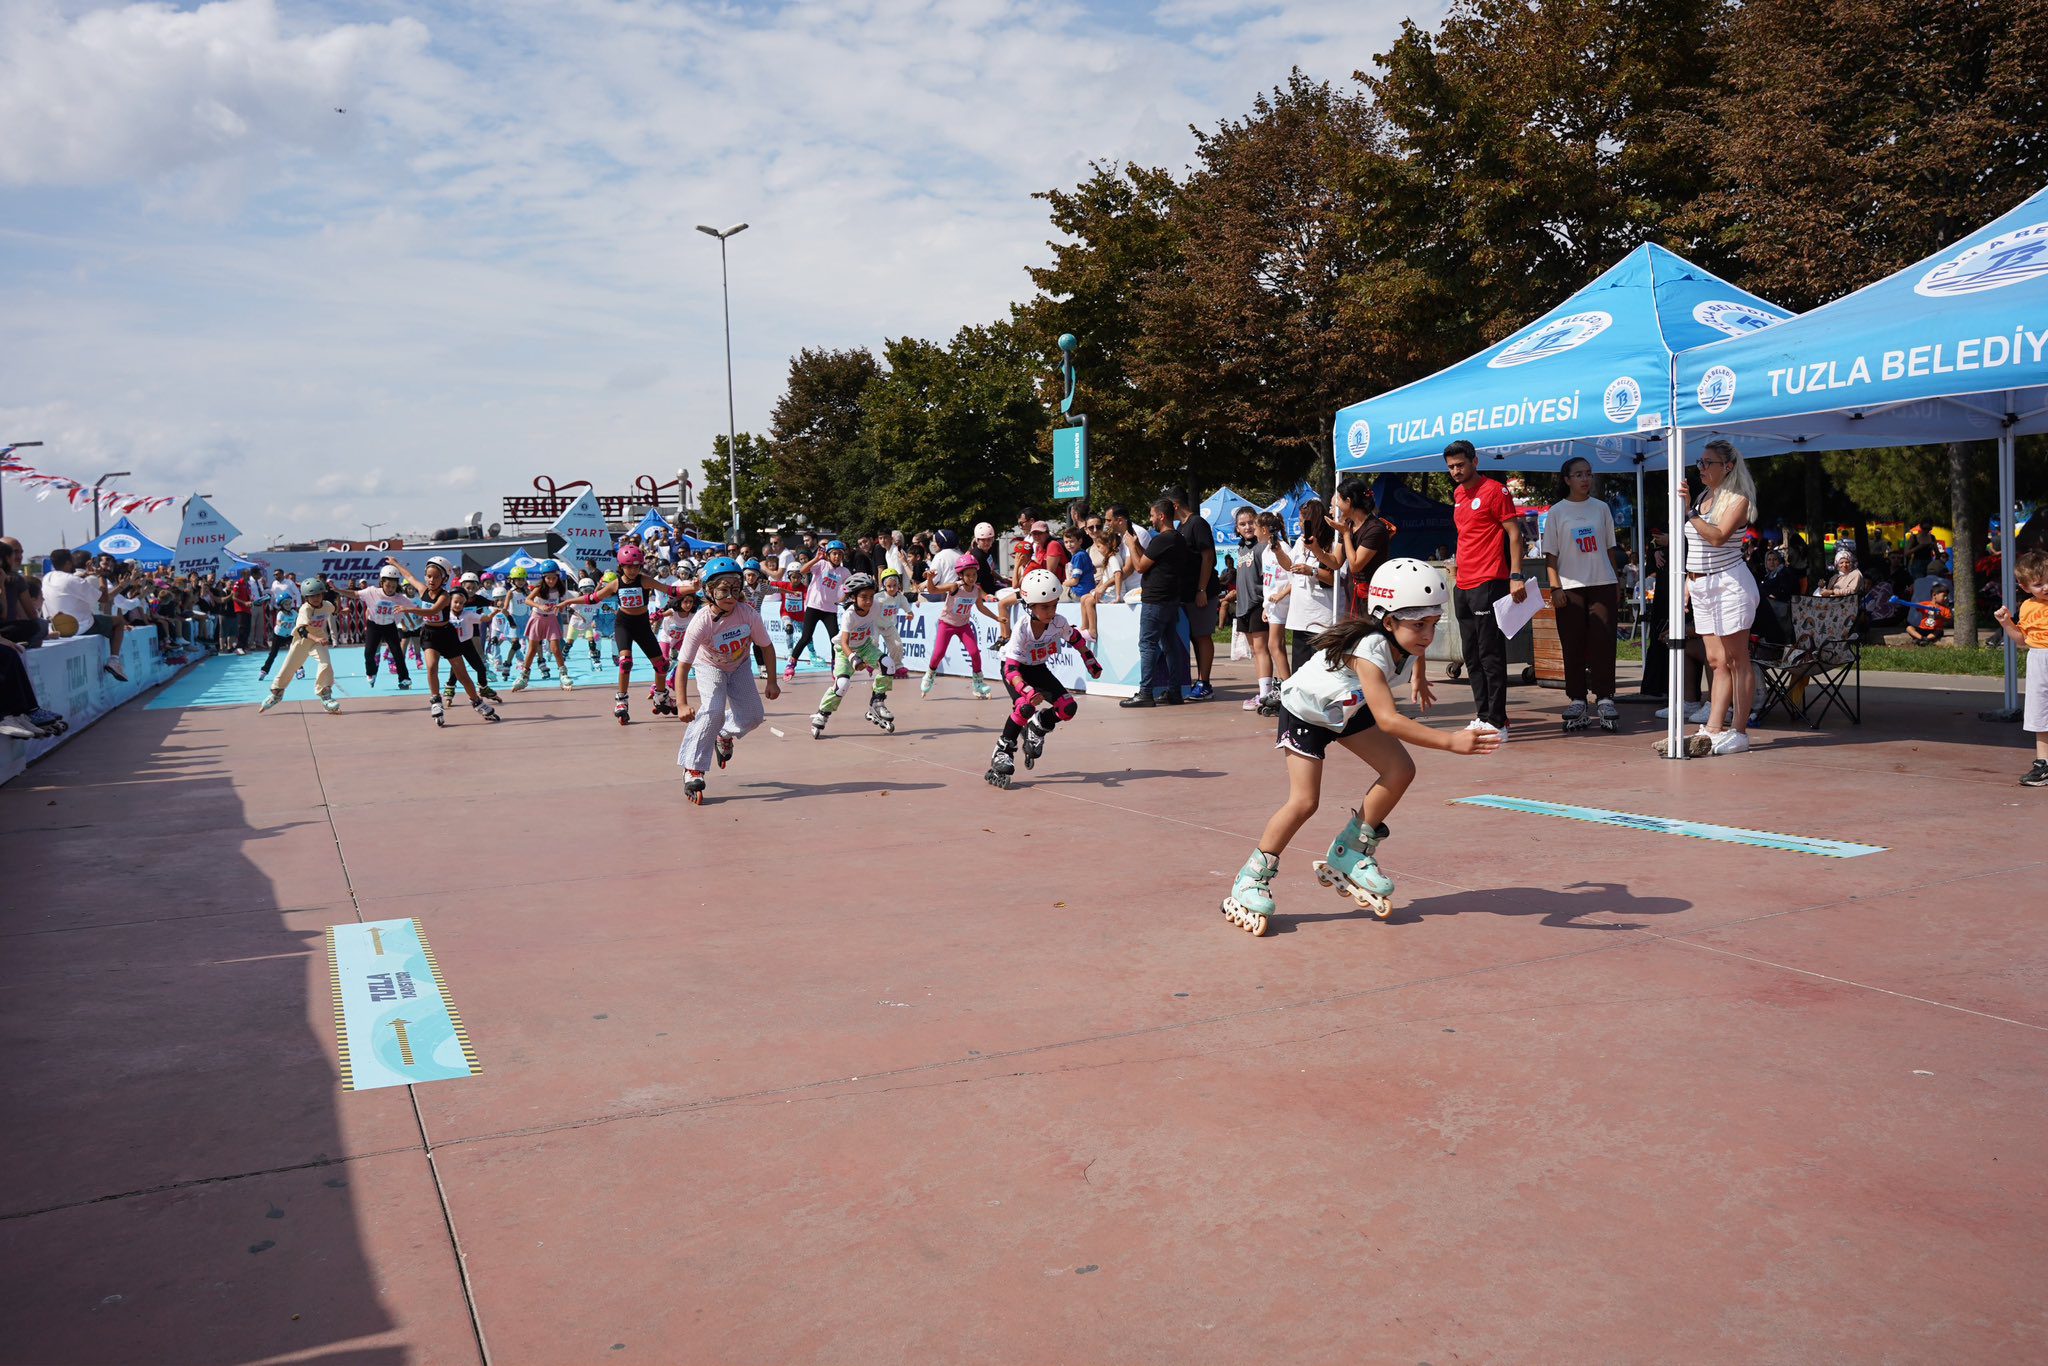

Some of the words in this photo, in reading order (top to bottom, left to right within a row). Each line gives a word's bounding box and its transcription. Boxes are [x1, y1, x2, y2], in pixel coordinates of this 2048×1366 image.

[1767, 356, 1872, 397] TUZLA
[1387, 415, 1445, 446] TUZLA
[1450, 389, 1580, 434] BELEDİYESİ
[567, 528, 605, 538] START
[184, 534, 225, 546] FINISH
[576, 548, 612, 556] TUZLA
[179, 557, 220, 569] TUZLA
[1369, 585, 1395, 599] ROCES
[621, 595, 643, 607] 223
[1047, 653, 1073, 669] ŞKANI
[366, 973, 397, 1002] TUZLA
